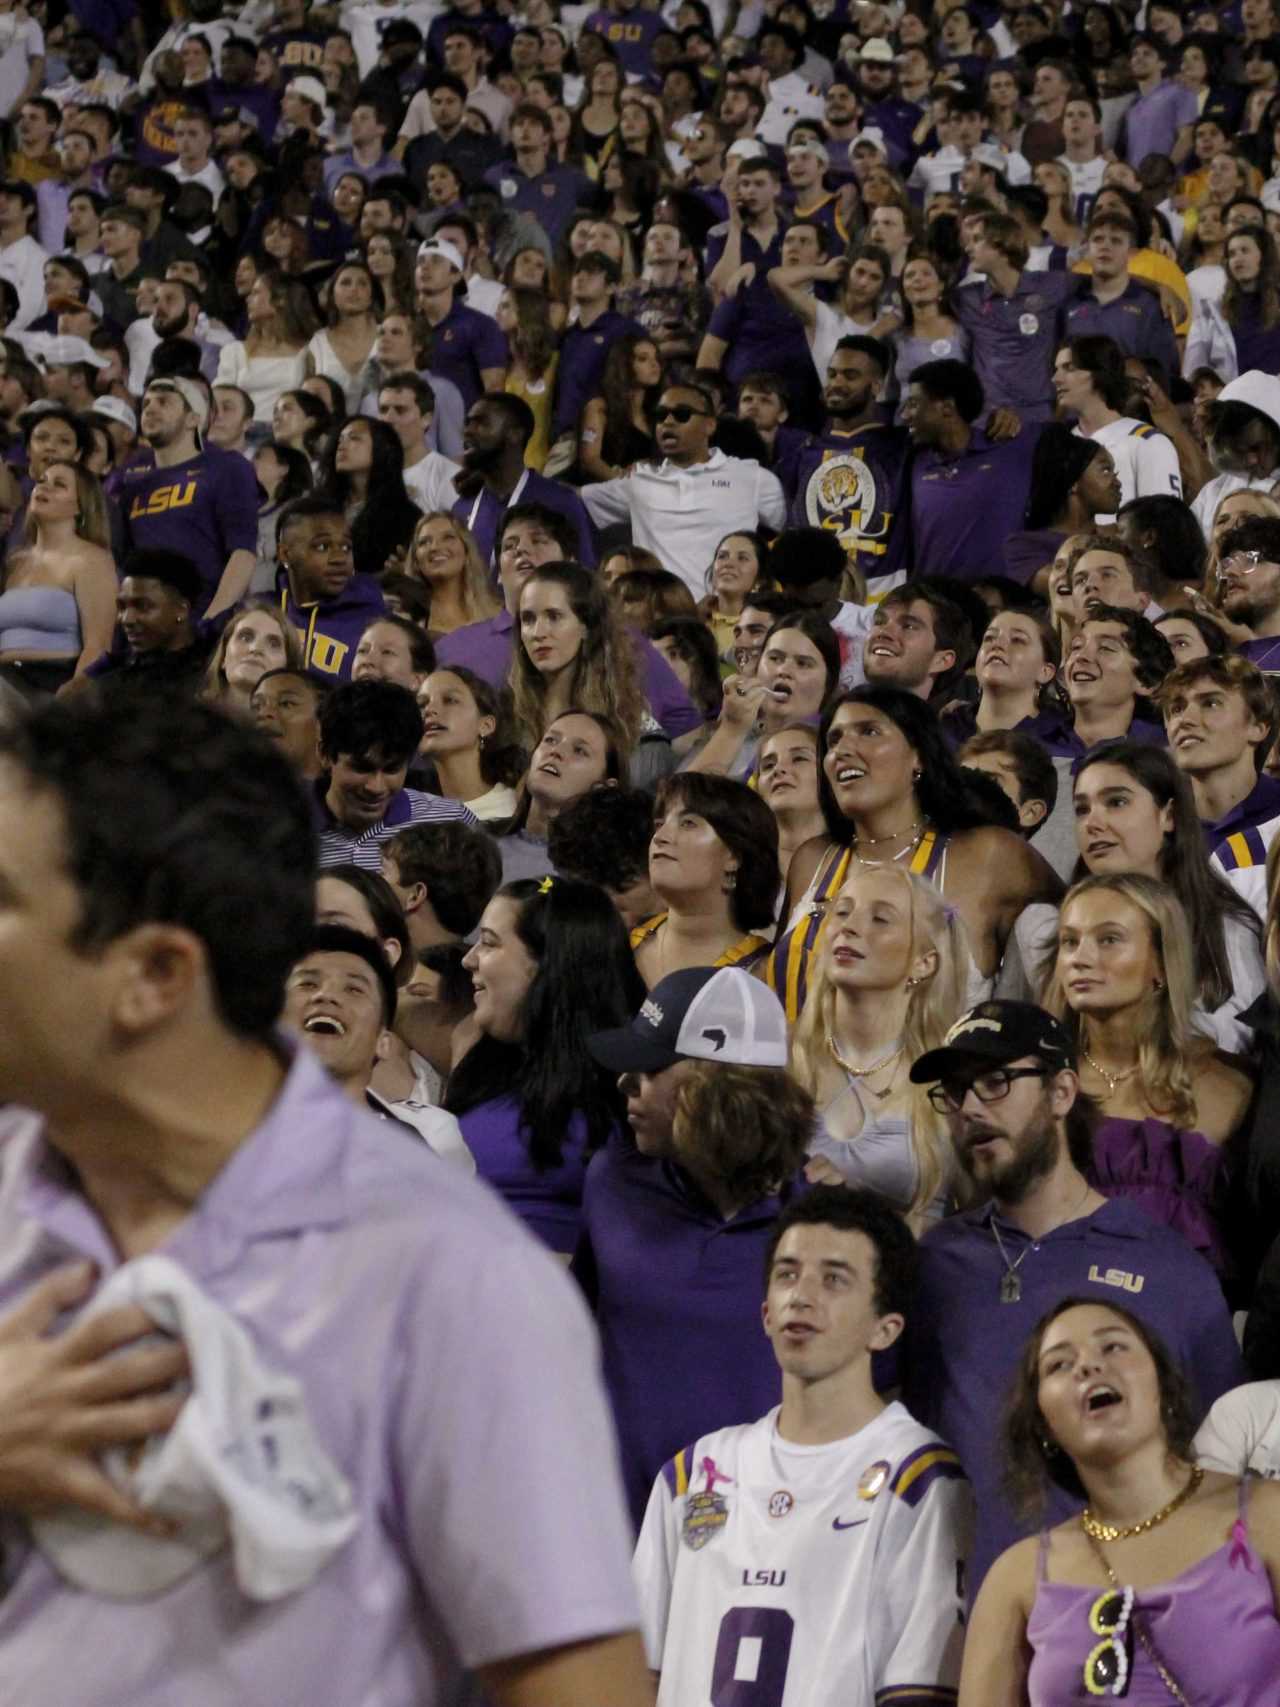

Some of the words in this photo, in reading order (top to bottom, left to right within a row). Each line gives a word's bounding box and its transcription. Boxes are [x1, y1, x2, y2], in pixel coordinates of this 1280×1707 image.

[129, 481, 197, 521] LSU
[1088, 1264, 1144, 1294] LSU
[743, 1569, 786, 1586] LSU
